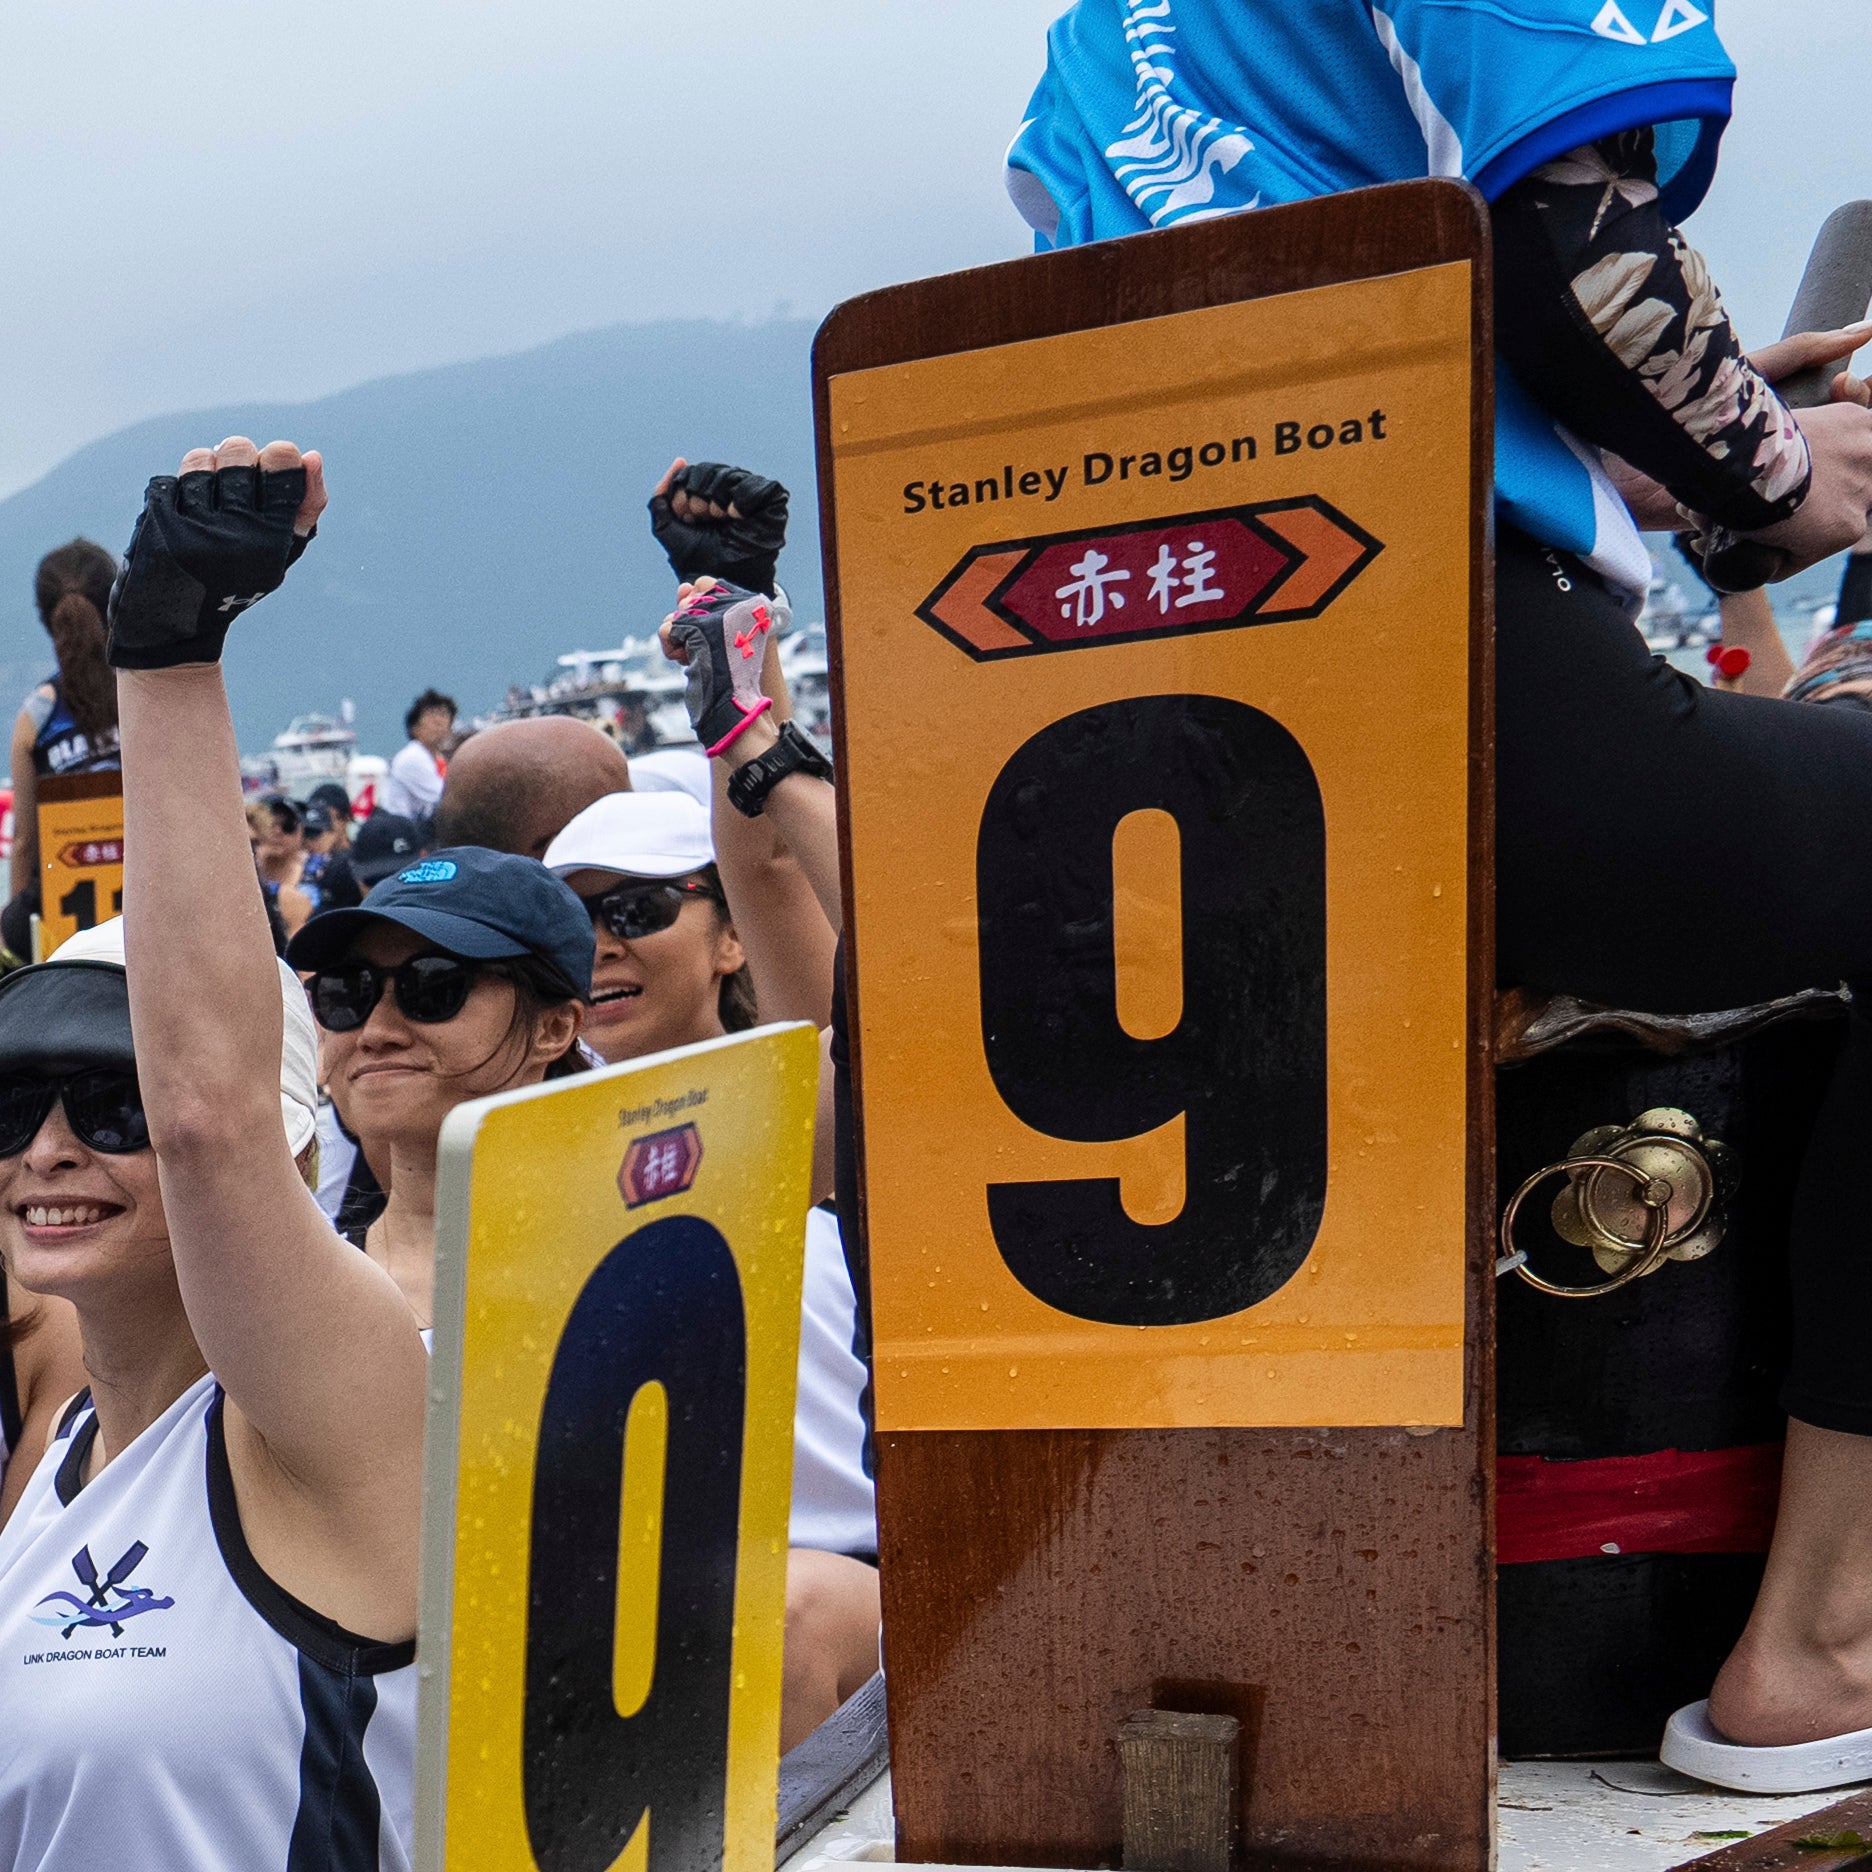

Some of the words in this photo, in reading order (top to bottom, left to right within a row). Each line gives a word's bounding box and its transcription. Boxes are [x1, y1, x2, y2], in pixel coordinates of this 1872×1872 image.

[902, 462, 1069, 515] Stanley
[1083, 434, 1257, 487] Dragon
[1274, 409, 1387, 457] Boat
[1055, 541, 1226, 627] 赤柱
[976, 694, 1327, 1326] 9
[24, 1653, 45, 1665] LINK
[46, 1649, 92, 1663] DRAGON
[94, 1647, 127, 1660] BOAT
[129, 1646, 167, 1658] TEAM
